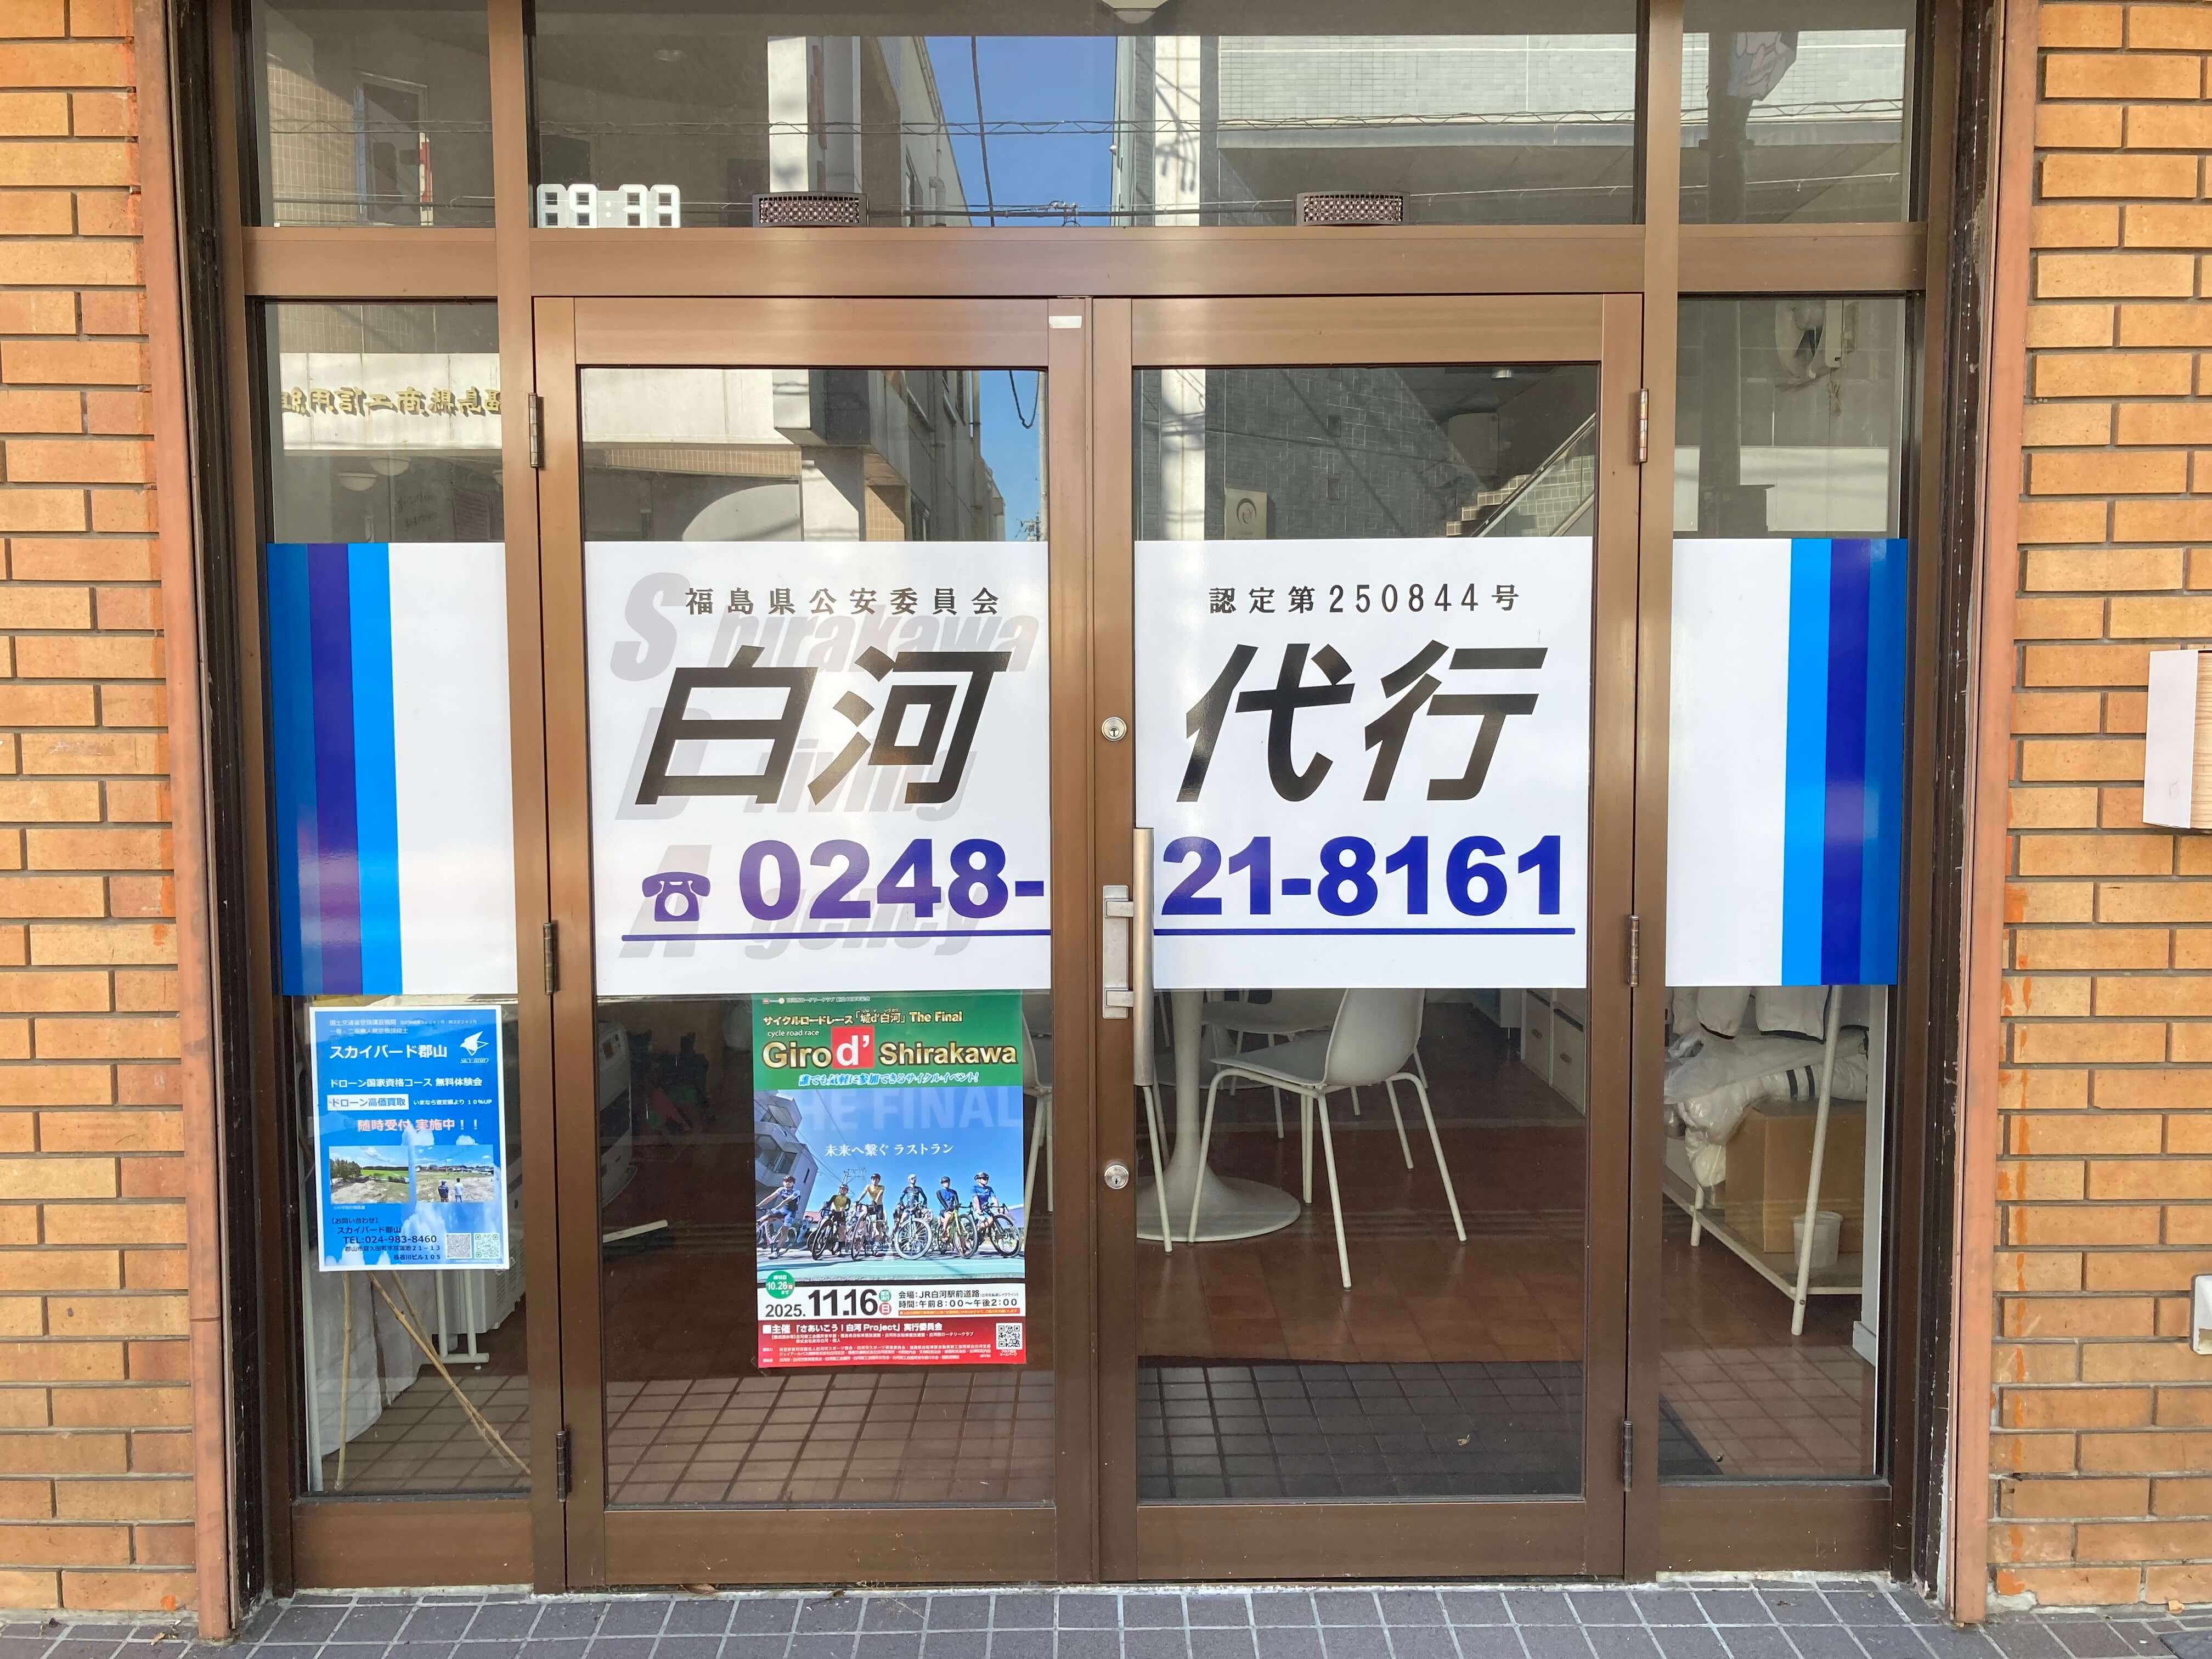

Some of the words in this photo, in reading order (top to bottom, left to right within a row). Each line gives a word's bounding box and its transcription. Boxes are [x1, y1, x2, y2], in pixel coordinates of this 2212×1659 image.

[685, 587, 998, 616] 福島県公安委員会
[1209, 583, 1519, 614] 認定第250844号
[635, 645, 1012, 806] 白河
[1176, 639, 1548, 803] 代行
[740, 838, 1044, 921] 0248-
[1161, 834, 1561, 917] 21-8161
[909, 1012, 931, 1023] The
[935, 1010, 963, 1022] Final
[767, 1030, 785, 1038] cycle
[329, 1045, 448, 1059] スカイバード郡山
[762, 1041, 832, 1069] Giro
[879, 1039, 1017, 1066] Shirakawa
[330, 1079, 433, 1088] ドローン国家資格コース
[435, 1077, 483, 1087] 無料体験会
[331, 1098, 406, 1107] ドローン高価買取
[357, 1119, 409, 1132] 随時受付
[825, 1144, 889, 1157] 未来へ繋ぐ
[895, 1143, 954, 1155] ラストラン
[343, 1235, 437, 1244] TEL:024-983-8460
[767, 1281, 787, 1290] 10.26
[765, 1304, 806, 1317] 2025.
[808, 1289, 878, 1316] 11.16
[904, 1322, 943, 1331] 実行委員会
